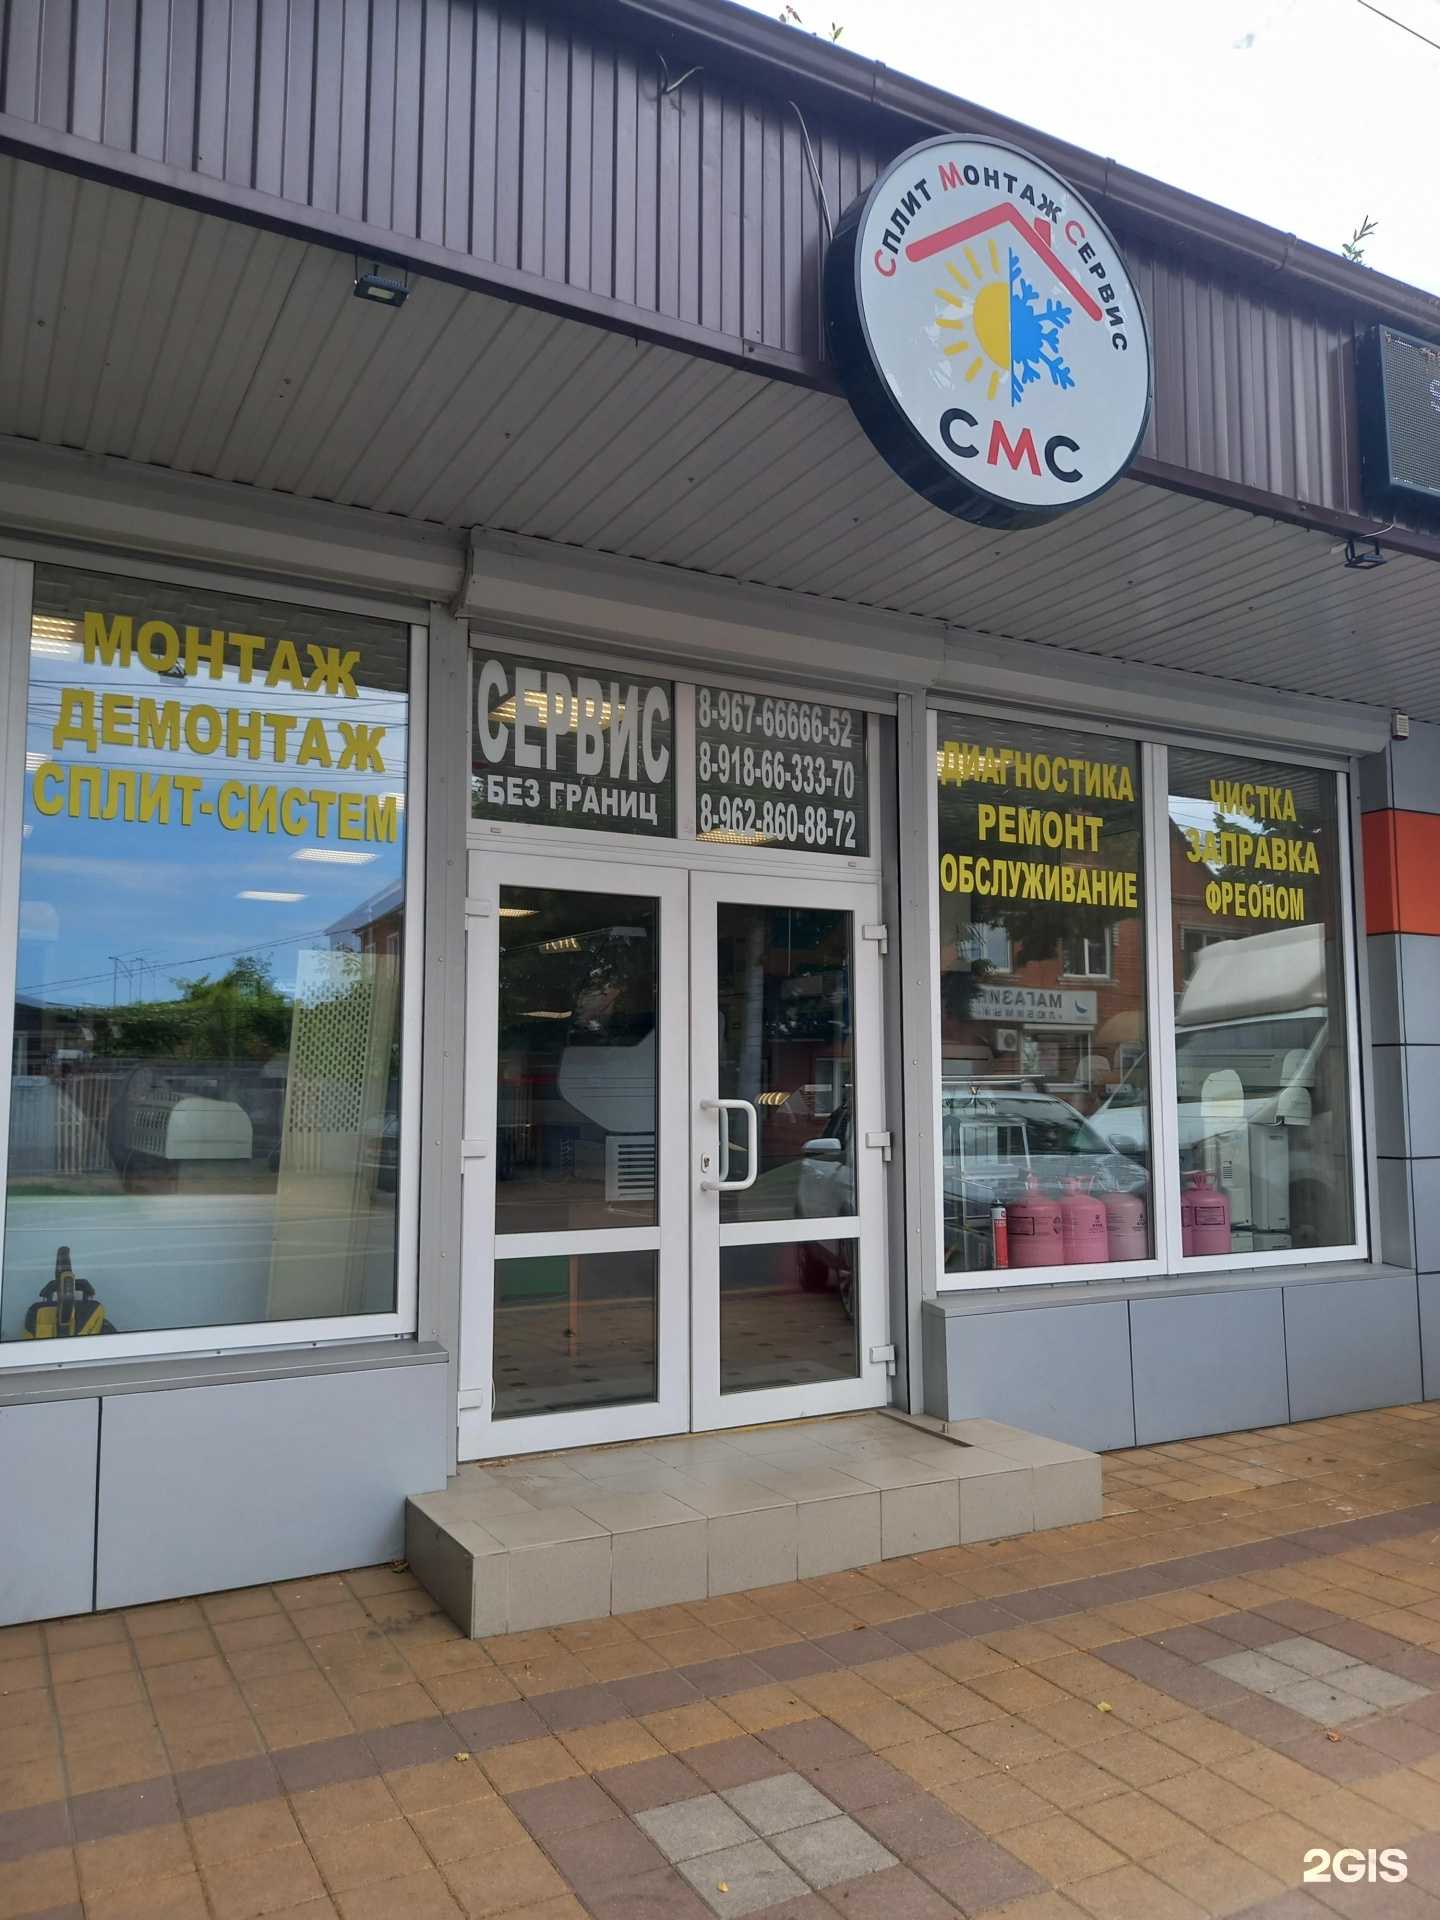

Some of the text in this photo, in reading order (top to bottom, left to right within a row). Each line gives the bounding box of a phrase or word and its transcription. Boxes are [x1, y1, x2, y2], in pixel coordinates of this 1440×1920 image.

[874, 160, 1129, 352] СПЛИТ МОНТАЖ СЕРВИС
[939, 407, 1084, 483] СМС
[82, 611, 361, 699] МОНТАЖ
[52, 687, 387, 773] ДЕМОНТАЖ
[477, 659, 671, 784] СЕРВИС
[698, 688, 852, 747] 8-967-66666-52
[699, 741, 855, 799] 8-918-66-333-70
[940, 740, 1135, 802] ДИАГНОСТИКА
[32, 761, 399, 844] СПЛИТ-СИСТЕМ
[487, 775, 658, 826] БЕЗ ГРАНИЦ
[700, 794, 857, 849] 8-962-860-88-72
[977, 804, 1104, 853] РЕМОНТ
[1209, 779, 1297, 822] ЧИСТКА
[1185, 828, 1321, 875] ЗАПРАВКА
[940, 853, 1138, 909] ОБСЛУЖИВАНИЕ
[1204, 881, 1305, 921] ФРЕОНОМ
